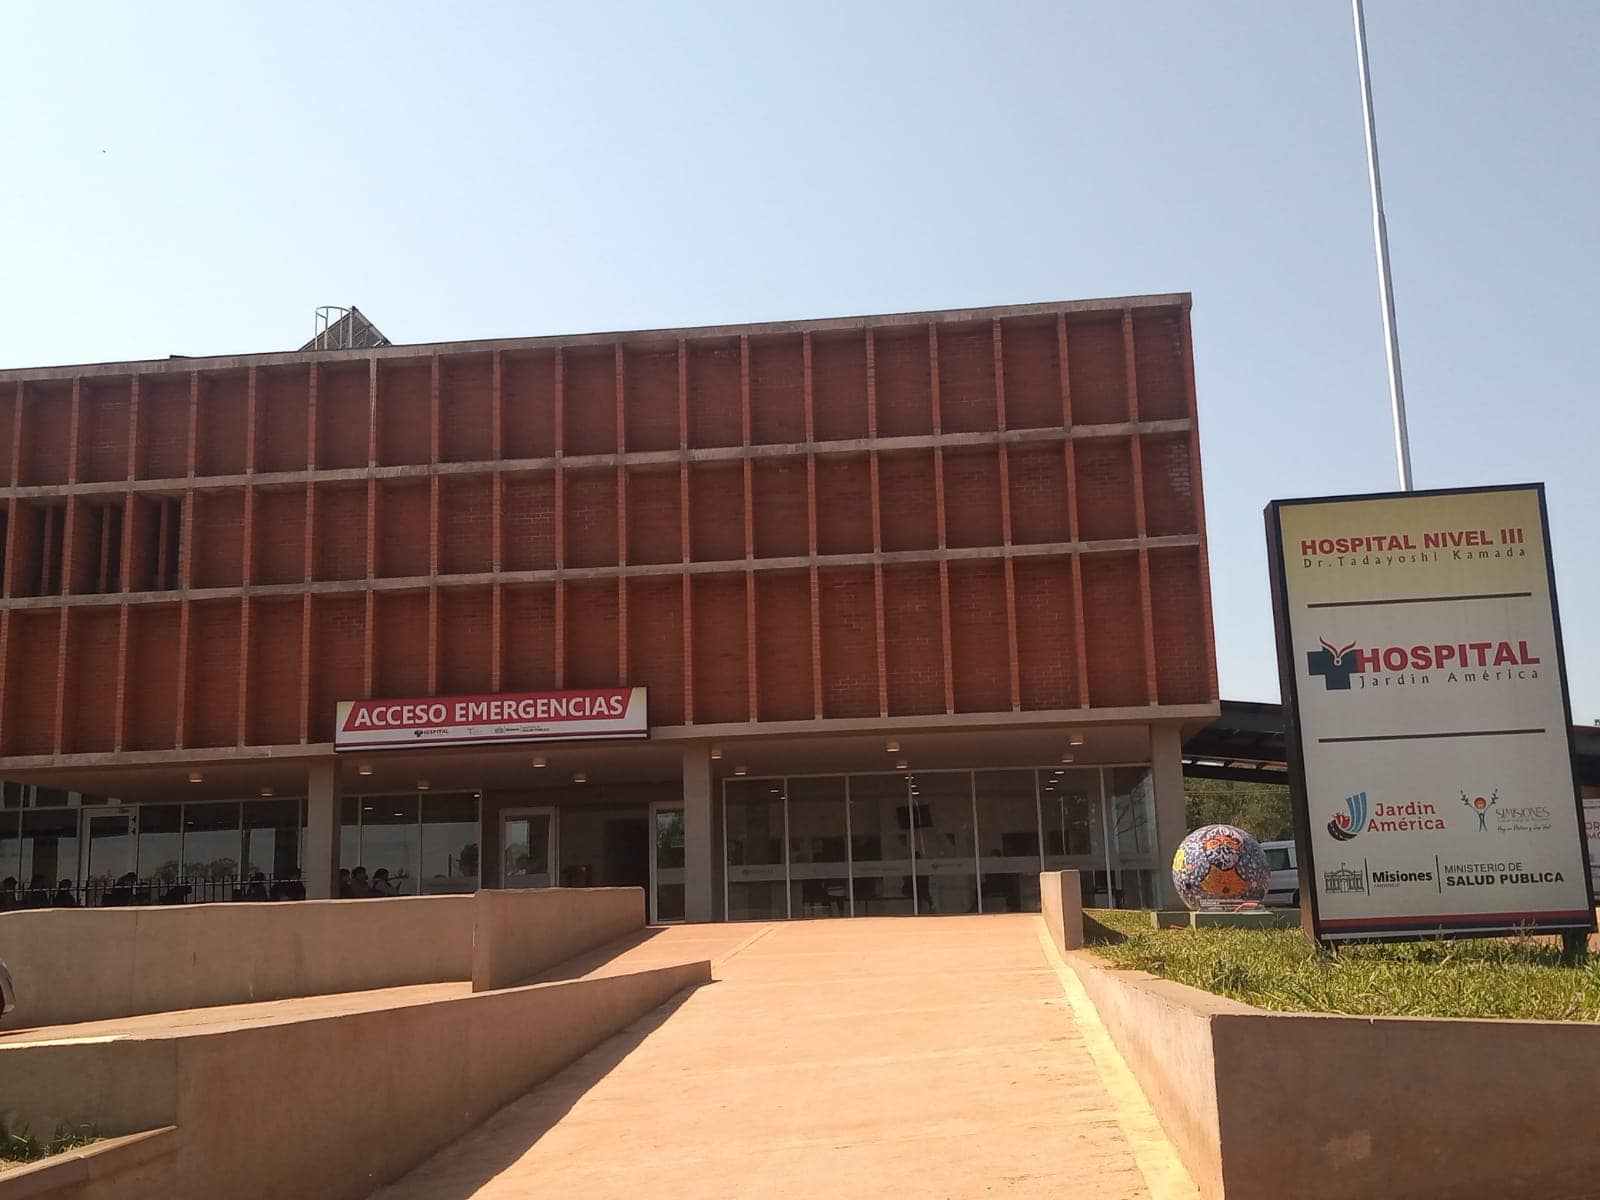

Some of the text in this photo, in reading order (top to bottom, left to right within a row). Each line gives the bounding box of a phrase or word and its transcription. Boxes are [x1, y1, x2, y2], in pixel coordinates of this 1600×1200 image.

[1301, 528, 1524, 556] HOSPITAL NIVEL III
[1452, 547, 1526, 560] Kamada
[1356, 641, 1541, 673] HOSPITAL
[1447, 668, 1539, 683] América
[354, 695, 624, 727] ACCESO EMERGENCIAS
[1375, 801, 1436, 817] Jardin
[1367, 816, 1446, 833] América
[1444, 862, 1524, 874] MINISTERIO DE
[1372, 870, 1433, 883] Misiones
[1446, 874, 1496, 887] SALUD
